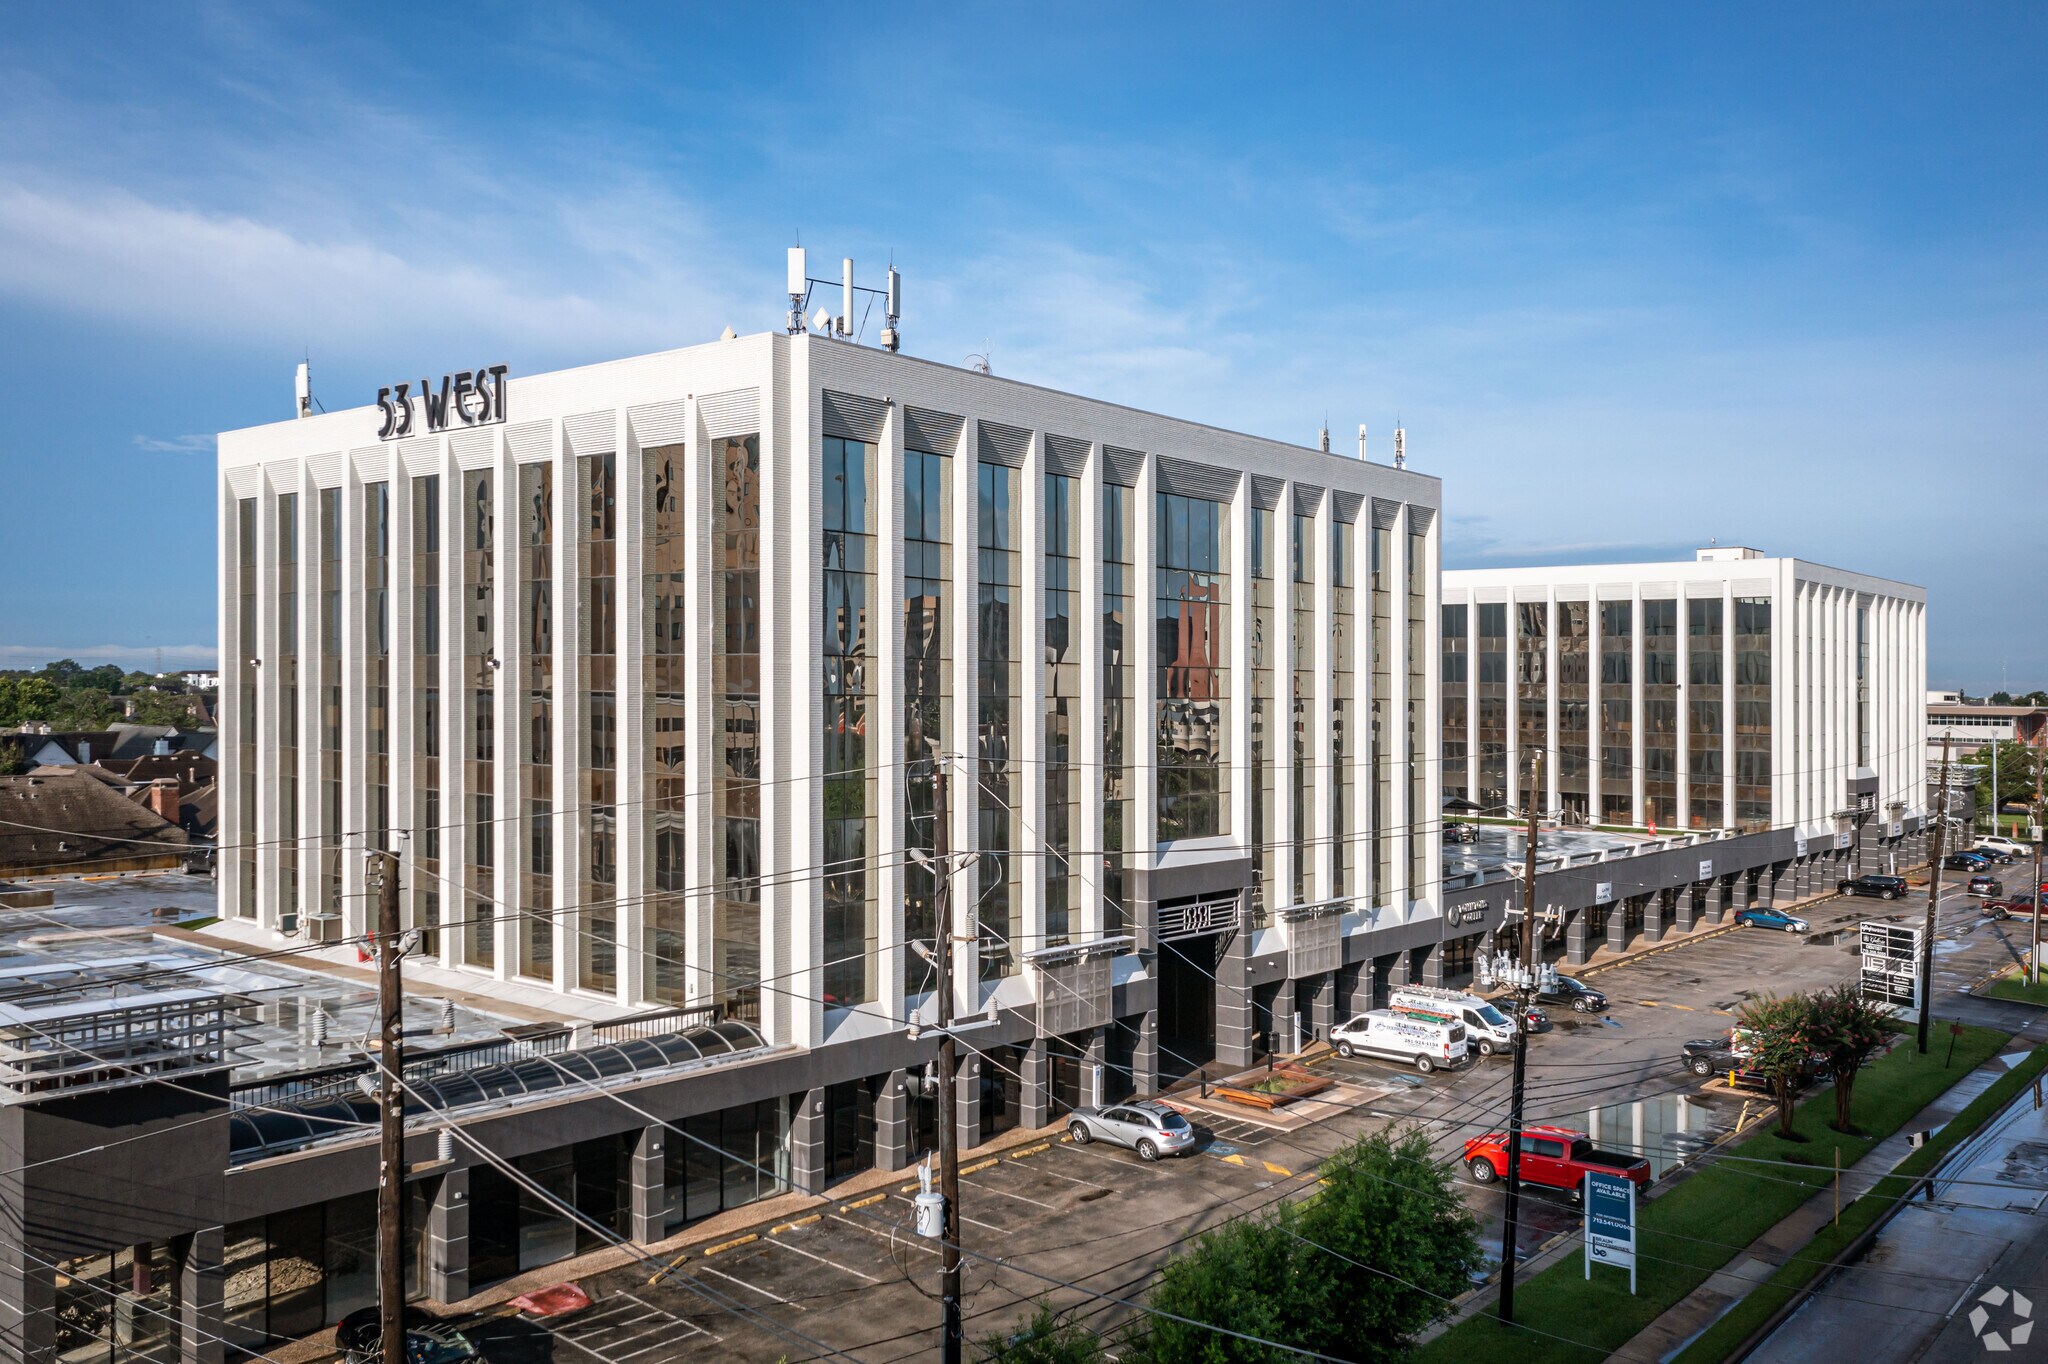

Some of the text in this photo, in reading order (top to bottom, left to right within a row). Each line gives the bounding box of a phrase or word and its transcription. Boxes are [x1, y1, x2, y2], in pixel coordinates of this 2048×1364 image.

[377, 365, 508, 438] 53 WEST
[1591, 1181, 1631, 1194] OFFICE SPACE
[1596, 1188, 1626, 1198] AVAILABLE
[1596, 1236, 1613, 1244] BRAUN
